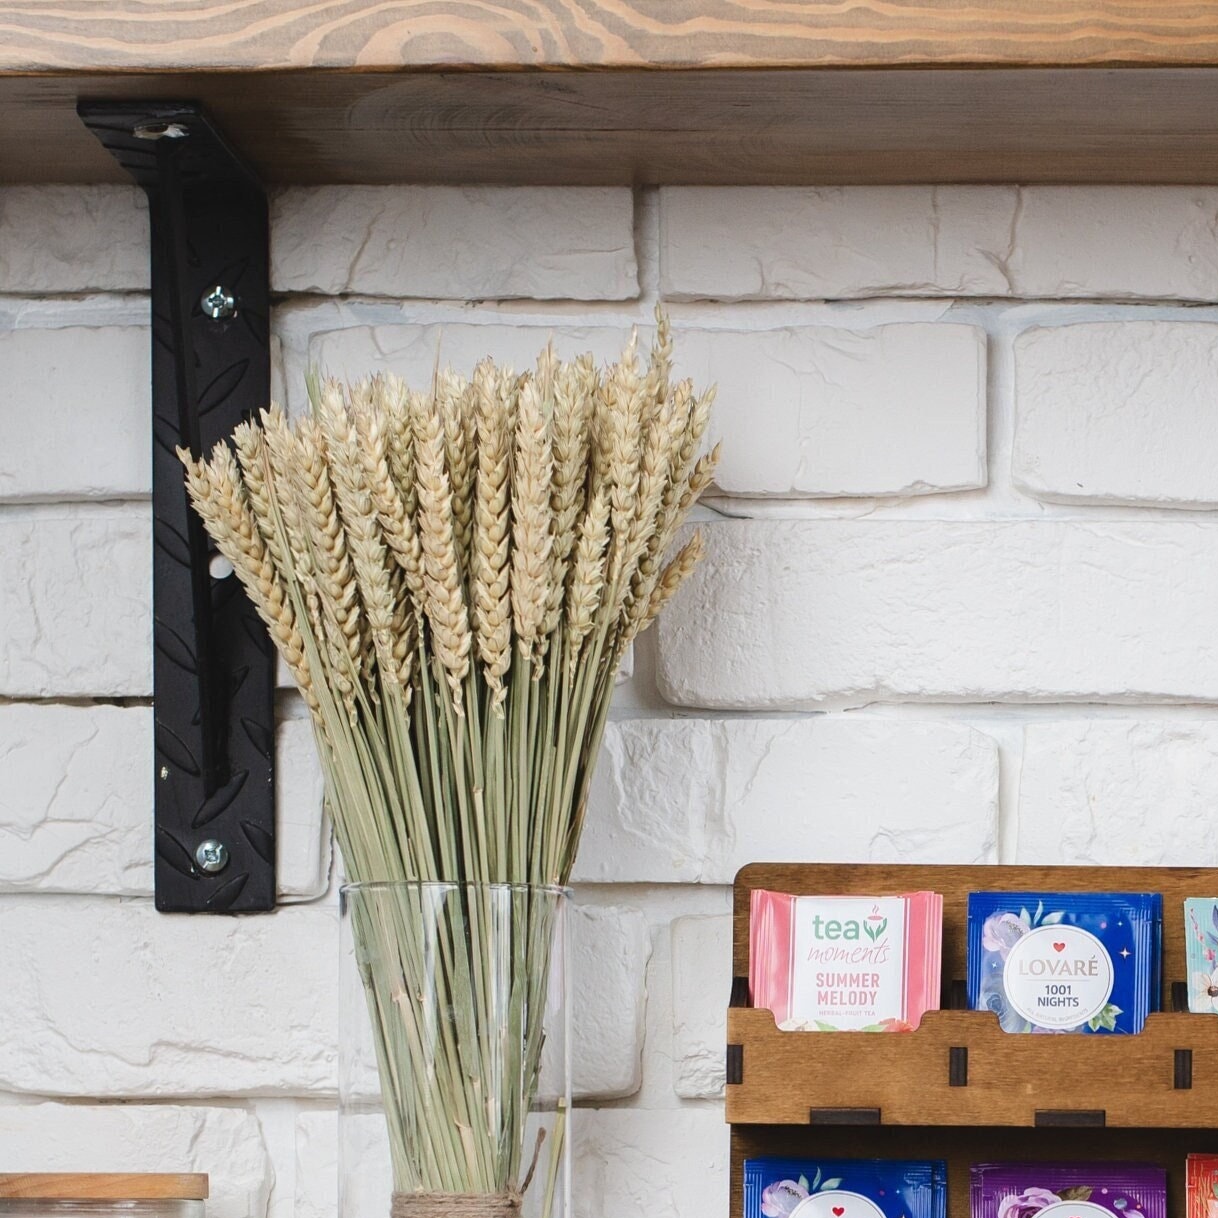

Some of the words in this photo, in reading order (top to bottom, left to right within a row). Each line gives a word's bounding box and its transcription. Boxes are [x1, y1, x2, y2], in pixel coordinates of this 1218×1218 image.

[812, 915, 860, 940] tea
[807, 937, 890, 964] moments
[1019, 955, 1099, 976] LOVARÉ
[816, 973, 880, 988] SUMMER
[1045, 985, 1071, 995] 1001
[818, 991, 877, 1005] MELODY
[1037, 997, 1079, 1007] NIGHTS
